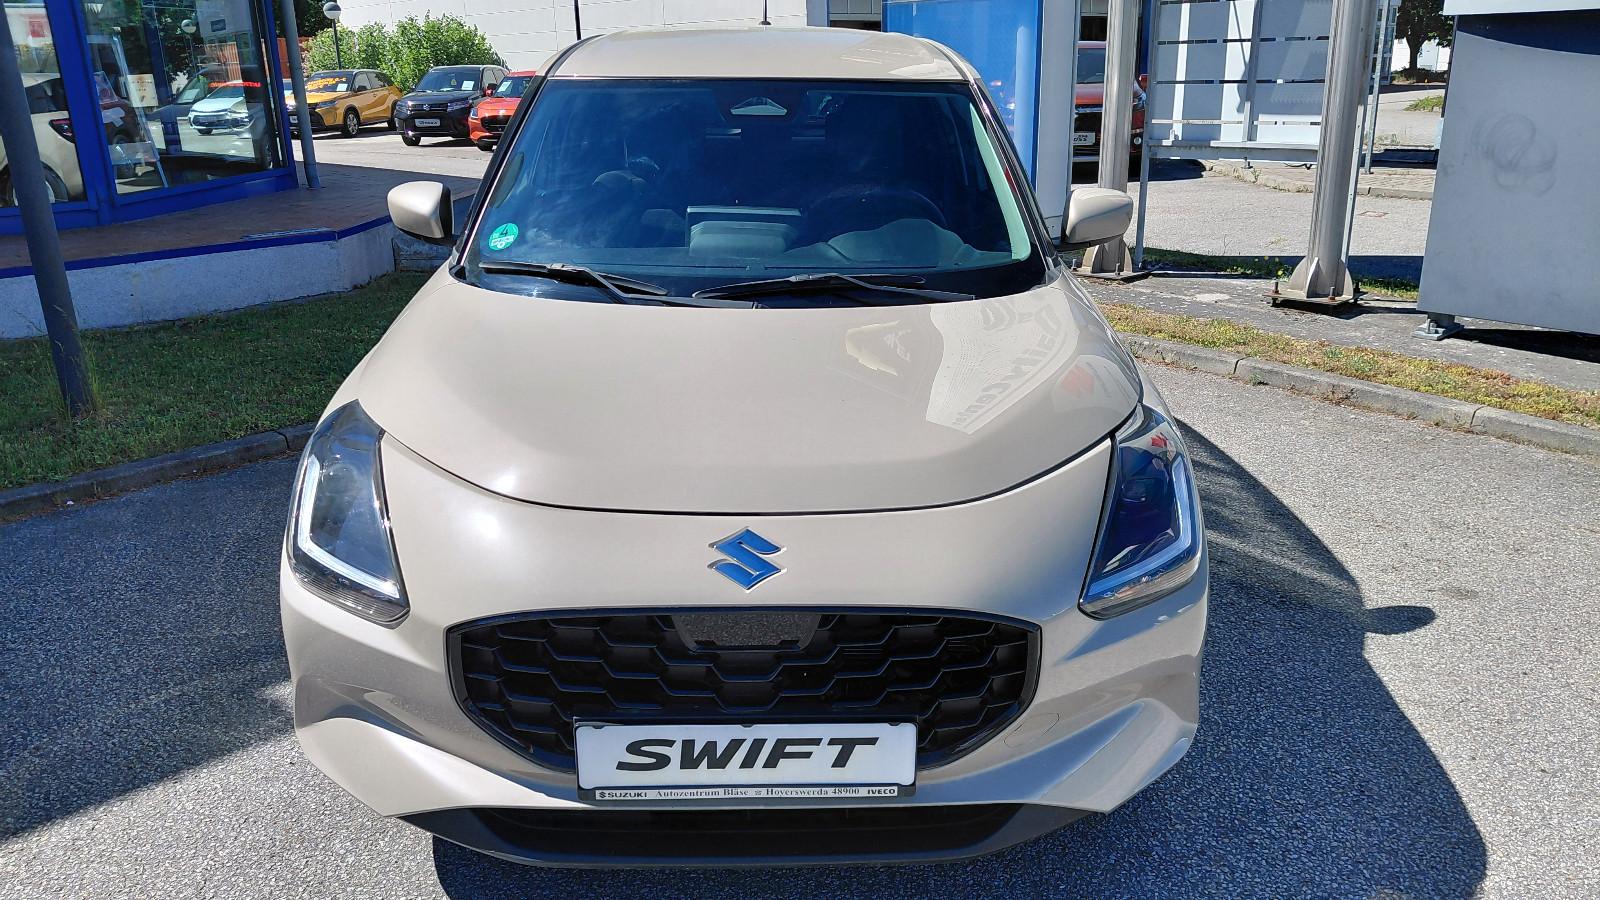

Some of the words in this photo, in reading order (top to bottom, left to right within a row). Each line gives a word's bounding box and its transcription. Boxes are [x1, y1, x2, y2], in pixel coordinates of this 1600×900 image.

[615, 737, 880, 771] SWIFT
[607, 791, 648, 799] SUZUKI
[655, 790, 721, 798] Autozentrum
[723, 788, 749, 797] Bläse
[766, 788, 829, 798] Hoyerswerda
[831, 787, 860, 795] 48900
